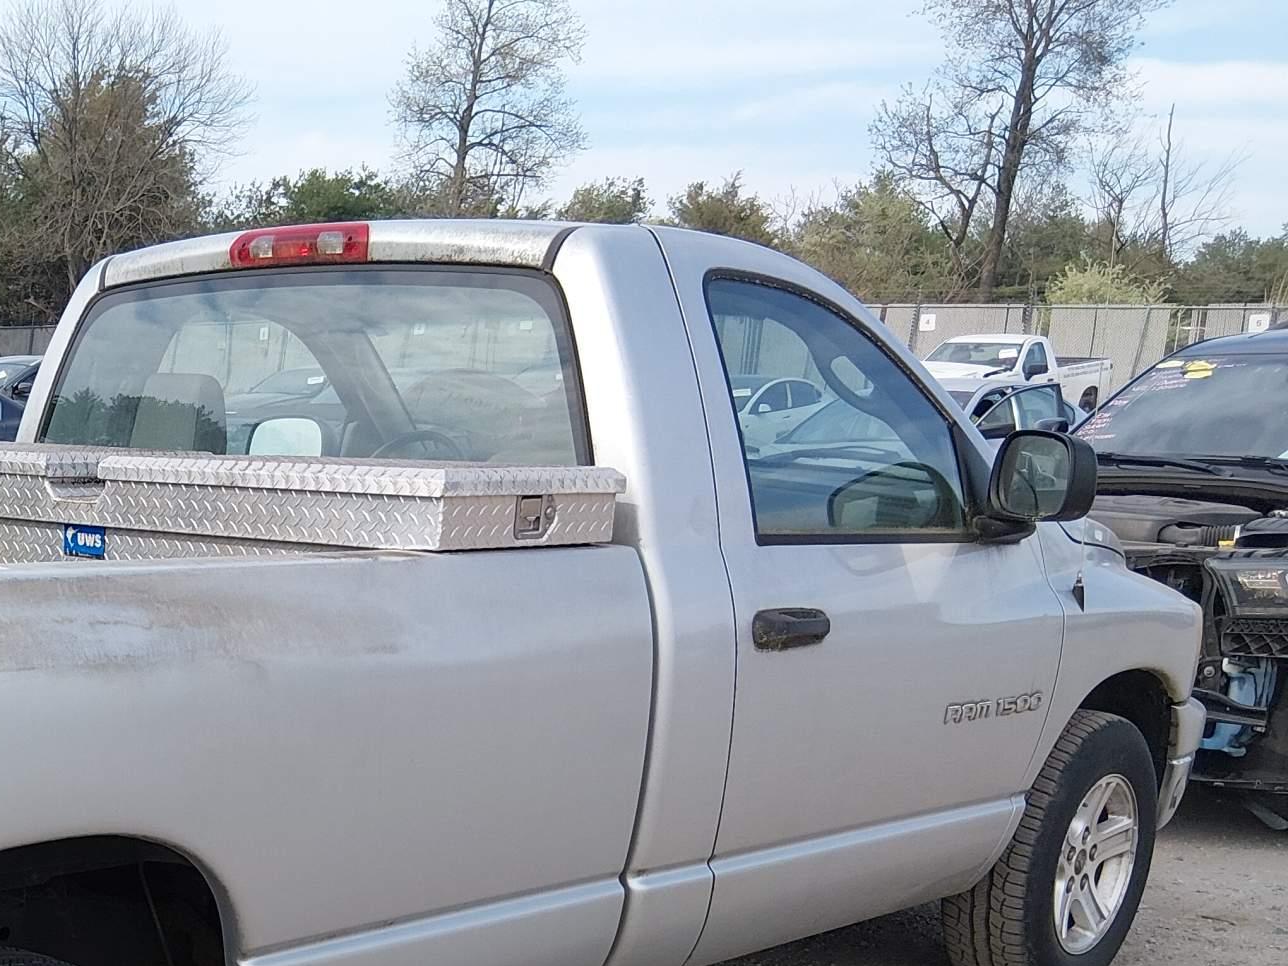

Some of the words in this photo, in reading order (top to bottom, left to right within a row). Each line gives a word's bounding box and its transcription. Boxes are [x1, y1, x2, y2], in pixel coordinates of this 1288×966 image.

[76, 532, 102, 548] UWS
[943, 701, 992, 725] RAM
[995, 690, 1043, 717] 1500
